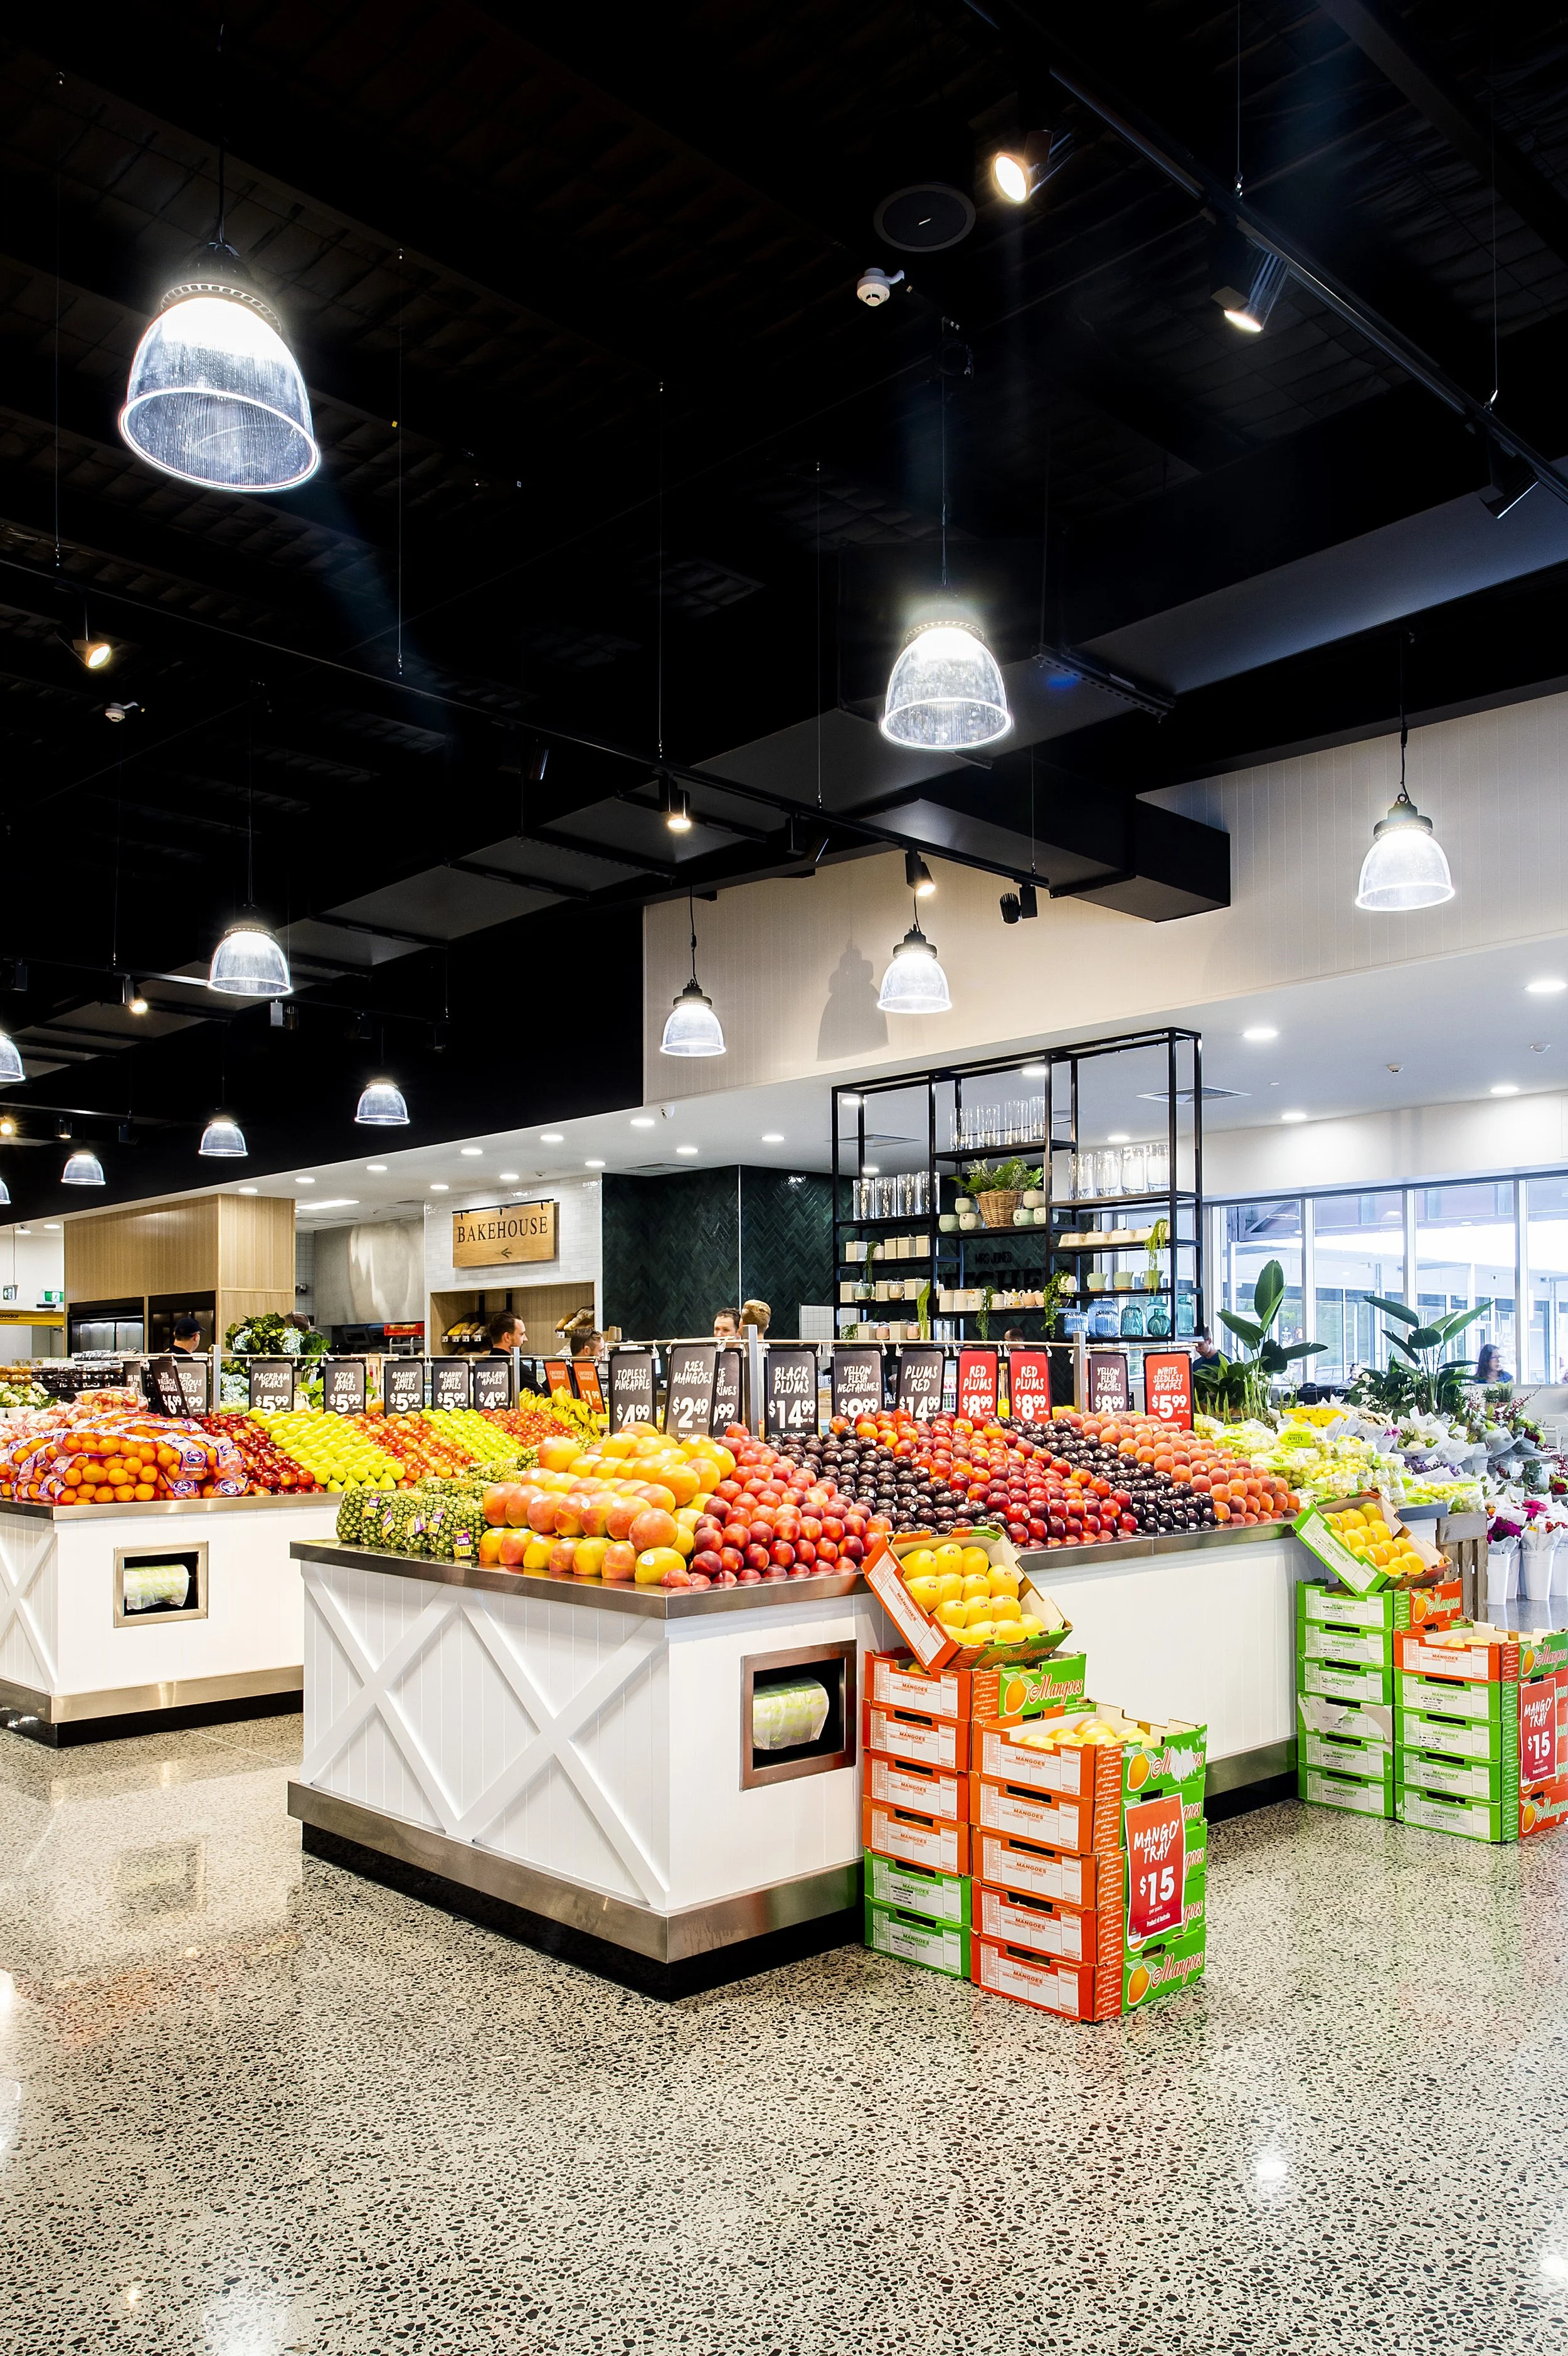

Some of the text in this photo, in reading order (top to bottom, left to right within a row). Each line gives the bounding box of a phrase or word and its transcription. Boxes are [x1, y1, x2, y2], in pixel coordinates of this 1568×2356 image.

[457, 1216, 548, 1243] BAKEHOUSE
[975, 1251, 1012, 1265] MRS JONES
[684, 1361, 704, 1372] R2E2
[844, 1365, 872, 1376] YELLOW
[904, 1366, 938, 1379] PLUMS
[969, 1365, 987, 1378] RED
[1020, 1365, 1038, 1378] RED
[1097, 1367, 1120, 1376] YELLOW
[1157, 1366, 1178, 1375] WHITE
[254, 1372, 290, 1381] PACKHAM
[392, 1371, 418, 1379] GRANNY
[439, 1371, 463, 1379] GRANNY
[477, 1371, 490, 1379] PINK
[617, 1369, 646, 1379] TOPLESS
[673, 1372, 713, 1385] MANGOES
[775, 1366, 808, 1381] BLACK
[848, 1374, 869, 1384] FLESH
[1101, 1374, 1117, 1383] FLESH
[1153, 1374, 1183, 1384] SEEDLESS
[260, 1380, 283, 1388] PEARS
[482, 1377, 502, 1386] APPLES
[615, 1379, 650, 1391] PINEAPPLE
[773, 1380, 809, 1394] PLUMS
[911, 1378, 931, 1392] RED
[963, 1377, 992, 1391] PLUMS
[1015, 1377, 1044, 1391] PLUMS
[1097, 1382, 1121, 1391] PEACHES
[1155, 1382, 1182, 1391] GRAPES
[334, 1384, 356, 1392] APPLES
[837, 1382, 879, 1394] NECTARINES
[897, 1592, 916, 1621] MANGOES
[1428, 1593, 1461, 1618] Mangoes
[1535, 1644, 1567, 1669] Mangoes
[902, 1683, 928, 1692] MANGOES
[1028, 1673, 1083, 1705] Mangoes
[1524, 1697, 1554, 1717] MANGO
[1530, 1712, 1547, 1728] TRAY
[899, 1732, 926, 1741] MANGOES
[1527, 1731, 1550, 1759] $15
[1015, 1756, 1046, 1766] MANGOES
[901, 1781, 926, 1793] MANGOES
[1014, 1808, 1043, 1819] MANGOES
[900, 1833, 927, 1844] MANGOES
[1134, 1819, 1179, 1850] MANGO
[1143, 1840, 1171, 1864] TRAY
[1016, 1862, 1047, 1874] MANGOES
[902, 1883, 930, 1894] MANGOES
[1140, 1865, 1175, 1906] $15
[1015, 1918, 1046, 1930] MANGOES
[903, 1933, 930, 1945] MANGOES
[1151, 1952, 1204, 1989] Mangoes
[1013, 1971, 1043, 1984] MANGOES
